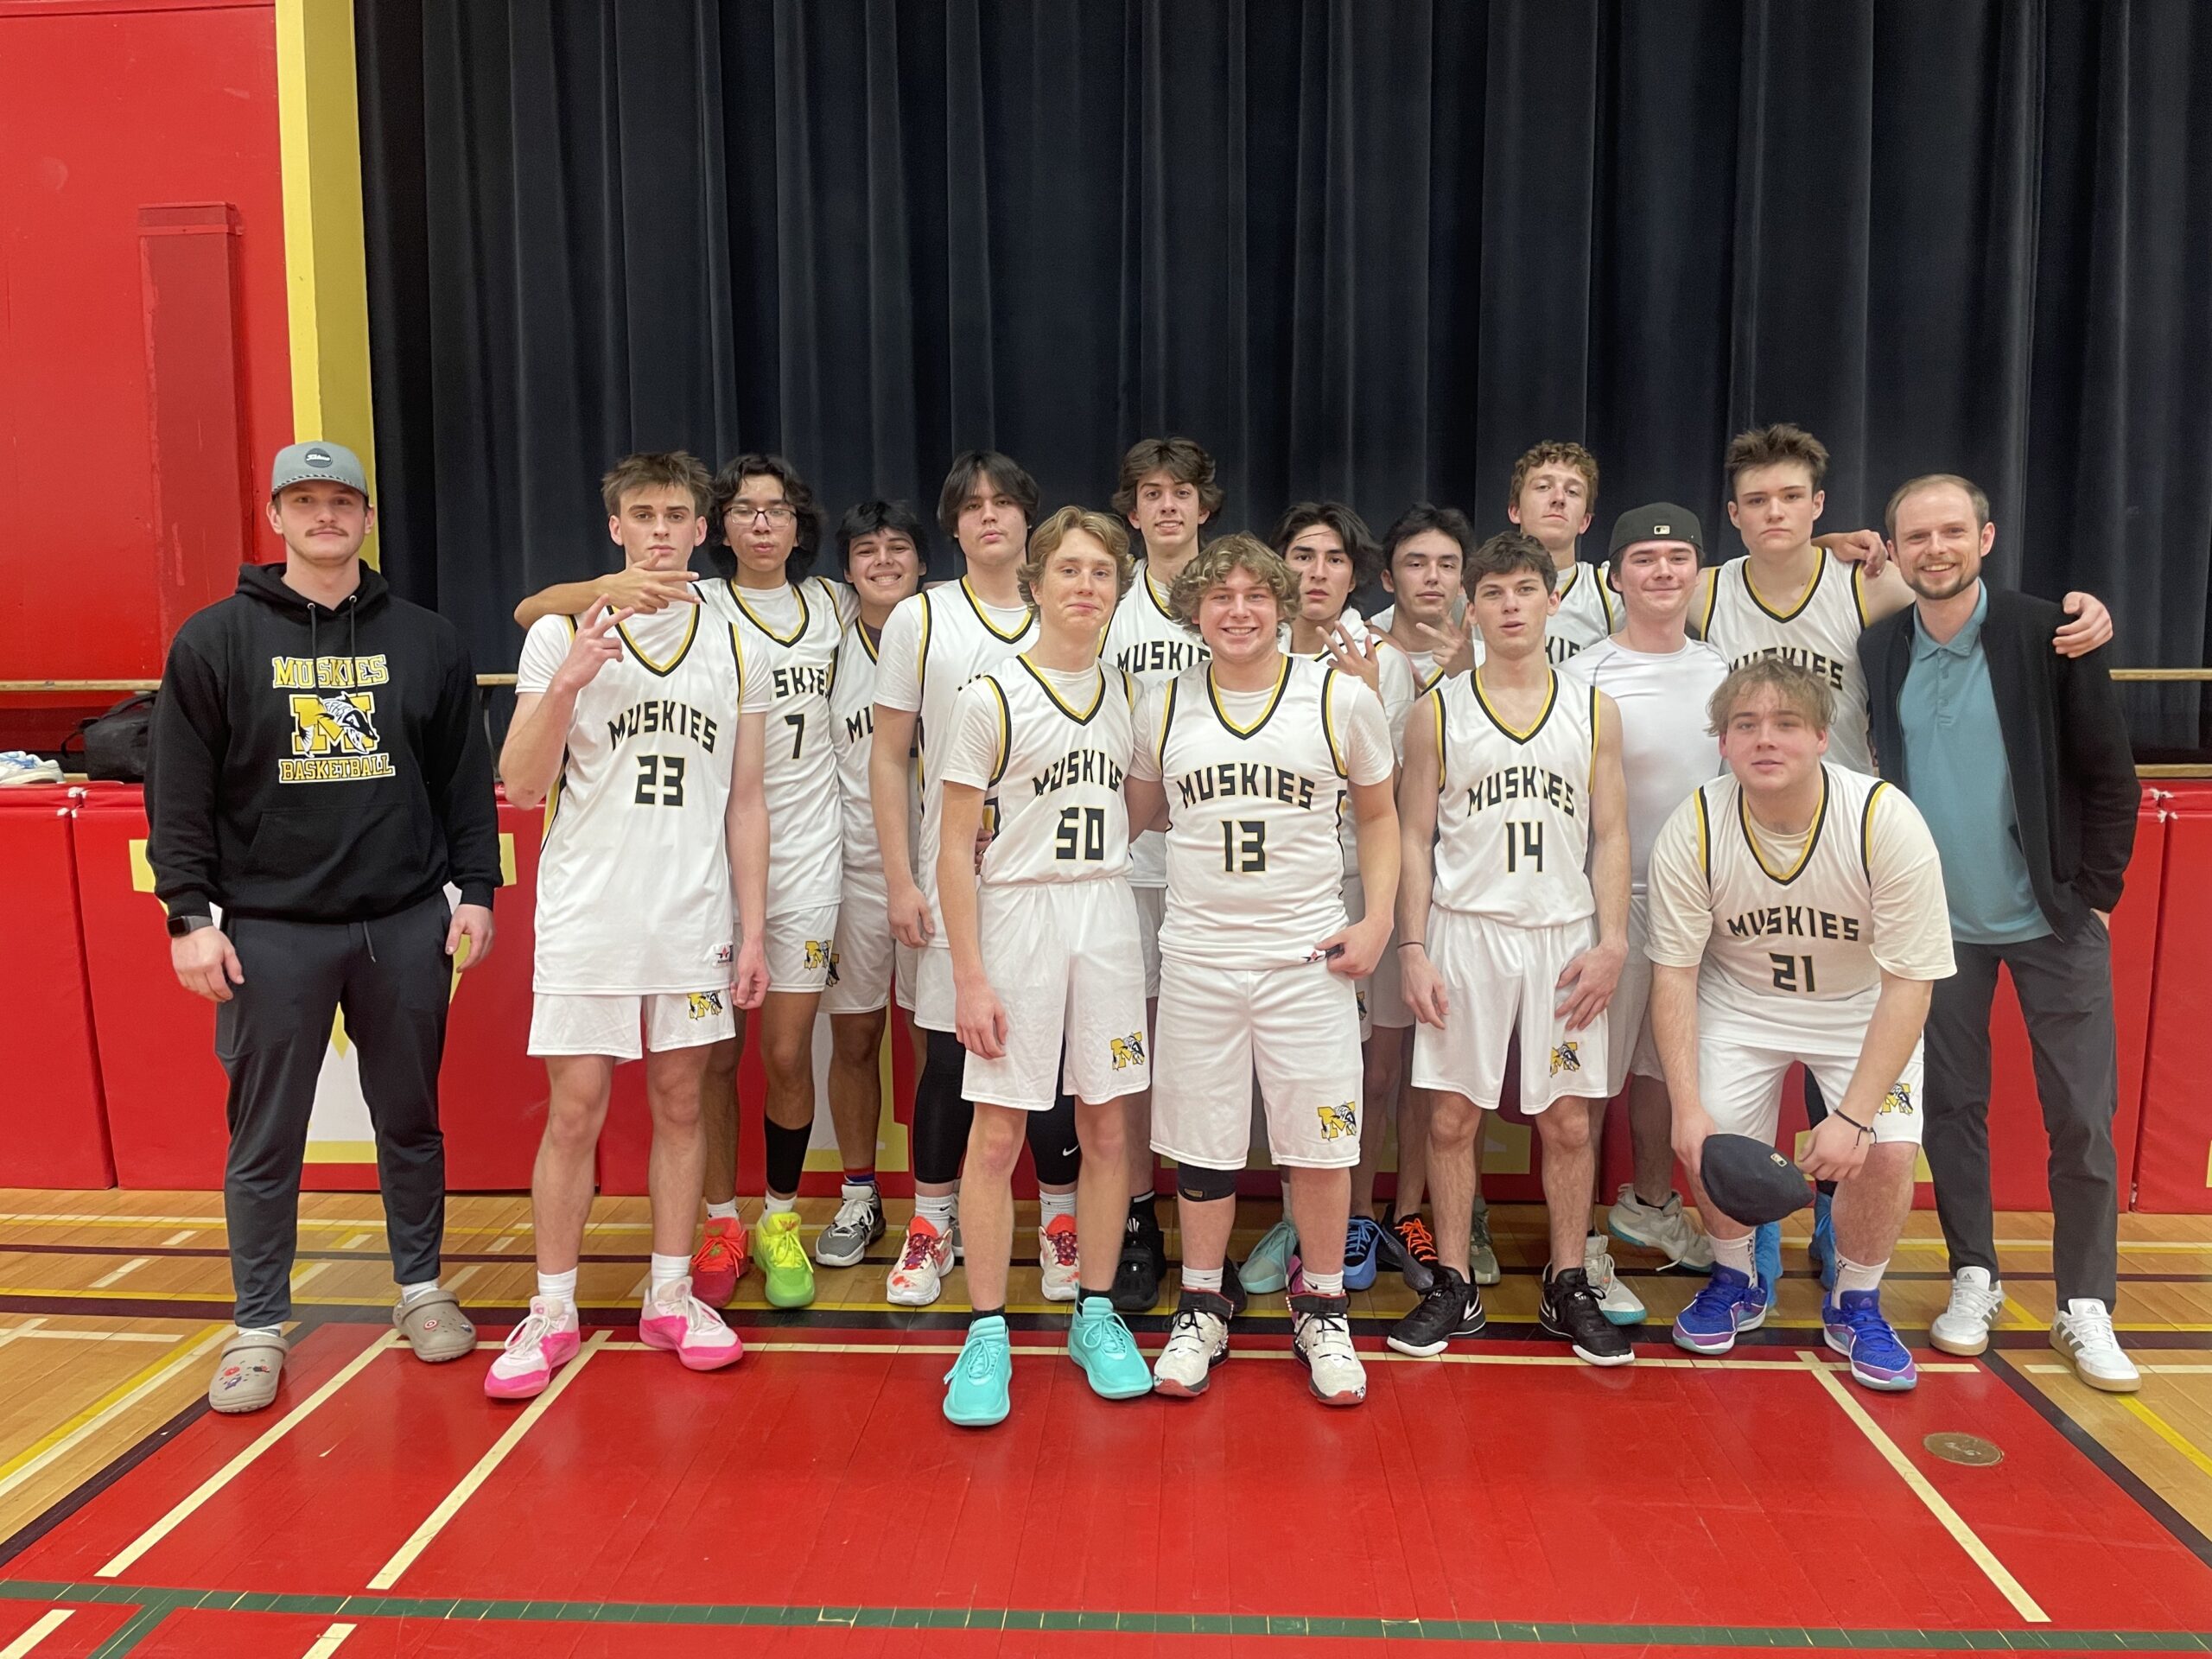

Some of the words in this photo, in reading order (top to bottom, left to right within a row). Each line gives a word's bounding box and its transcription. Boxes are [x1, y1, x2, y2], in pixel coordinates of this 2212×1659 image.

[272, 654, 390, 689] MUSKIES
[607, 700, 717, 753] MUSKIES
[785, 714, 804, 760] 7
[278, 753, 396, 784] BASKETBALL
[634, 754, 685, 807] 23
[1176, 763, 1316, 810] MUSKIES
[1466, 766, 1575, 817] MUSKIES
[1055, 806, 1105, 861] 50
[1221, 820, 1267, 873] 13
[1506, 822, 1544, 874] 14
[1726, 905, 1860, 942] MUSKIES
[1769, 951, 1815, 993] 21
